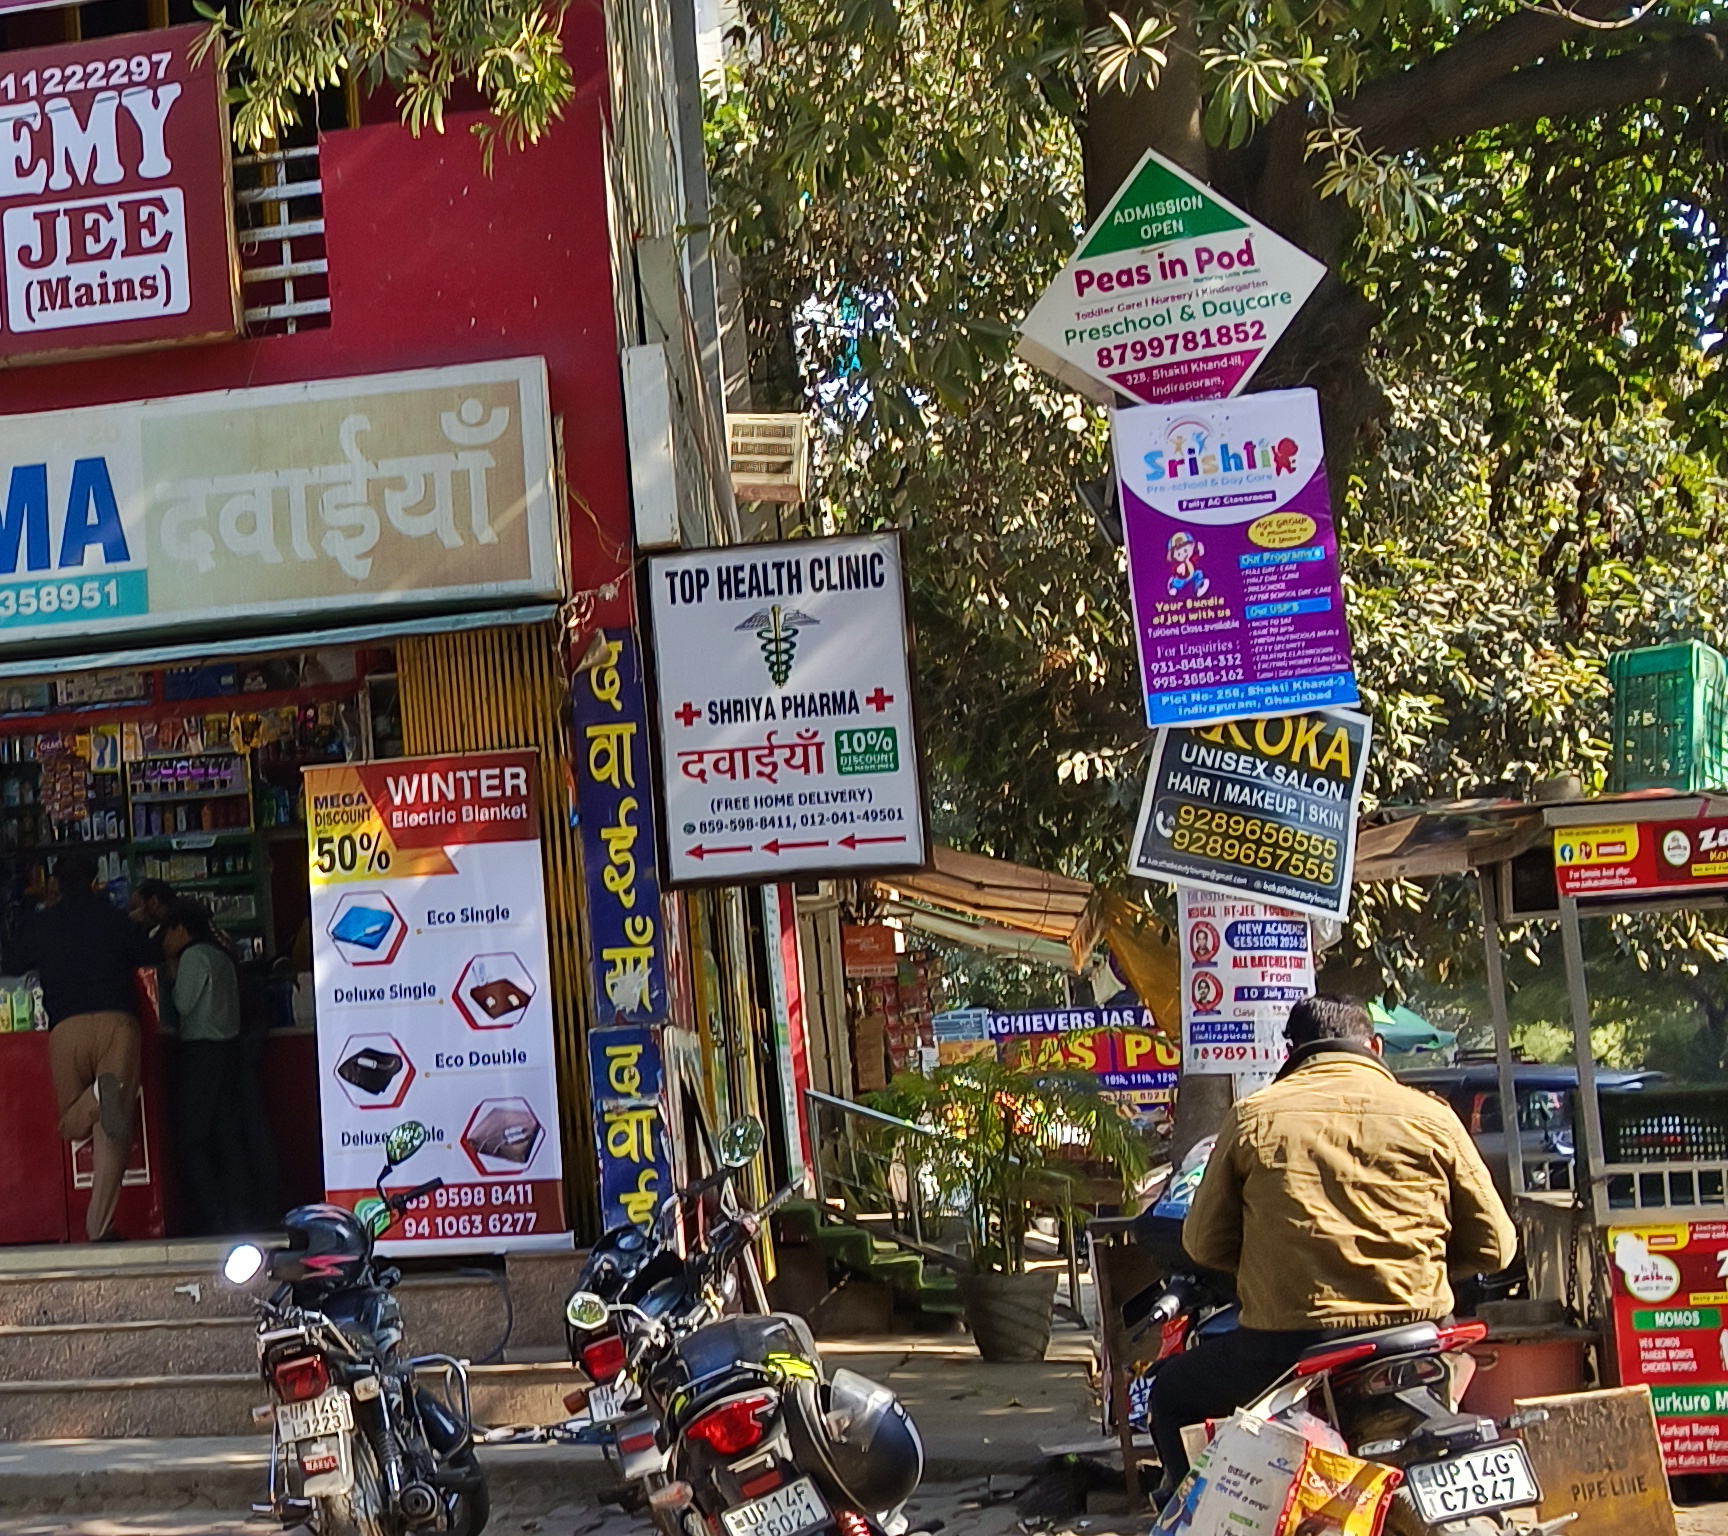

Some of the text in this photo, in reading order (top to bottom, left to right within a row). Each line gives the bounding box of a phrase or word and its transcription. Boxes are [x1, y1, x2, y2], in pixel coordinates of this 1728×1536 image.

[1113, 194, 1204, 226] ADMISSION
[16, 195, 174, 271] JEE
[1140, 218, 1185, 240] OPEN
[1075, 264, 1152, 298] Peas
[1157, 251, 1188, 282] in
[1194, 237, 1256, 274] Pod
[24, 263, 174, 324] (Mains)
[1065, 289, 1292, 347] Preschool & Daycare
[1096, 318, 1267, 370] 8799781852
[1142, 439, 1269, 482] Srishti
[160, 398, 511, 581] दवाईयाँ
[665, 551, 886, 606] TOP HEALTH CLINIC
[707, 689, 861, 726] SHRIYA PHARMA
[677, 728, 826, 785] दवाईयाँ
[838, 730, 894, 755] 10%
[840, 751, 896, 766] DISCOUNT
[387, 767, 528, 806] WINTER
[1180, 742, 1345, 803] UNISEX SALON
[313, 792, 369, 810] MEGA
[392, 802, 528, 829] Electric Blanket
[710, 787, 874, 814] (FREE HOME DELIVERY)
[1167, 771, 1345, 831] HAIR MAKEUP SKIN
[314, 808, 374, 827] DISCOUNT
[1178, 805, 1338, 861] 9289656555
[316, 830, 391, 874] 50%
[1172, 828, 1335, 885] 9289657555
[427, 904, 510, 926] Eco Single
[1237, 923, 1263, 935] NEW
[334, 981, 437, 1004] Deluxe Single
[986, 1007, 1136, 1036] ACHIEVERS IAS
[435, 1047, 528, 1070] Eco Double
[435, 1184, 533, 1209] 9598 8411
[404, 1212, 538, 1238] 94 1063 6277
[1654, 1311, 1700, 1327] MOMOS
[1441, 1480, 1517, 1513] C7847
[1571, 1474, 1648, 1503] PIPE LINE
